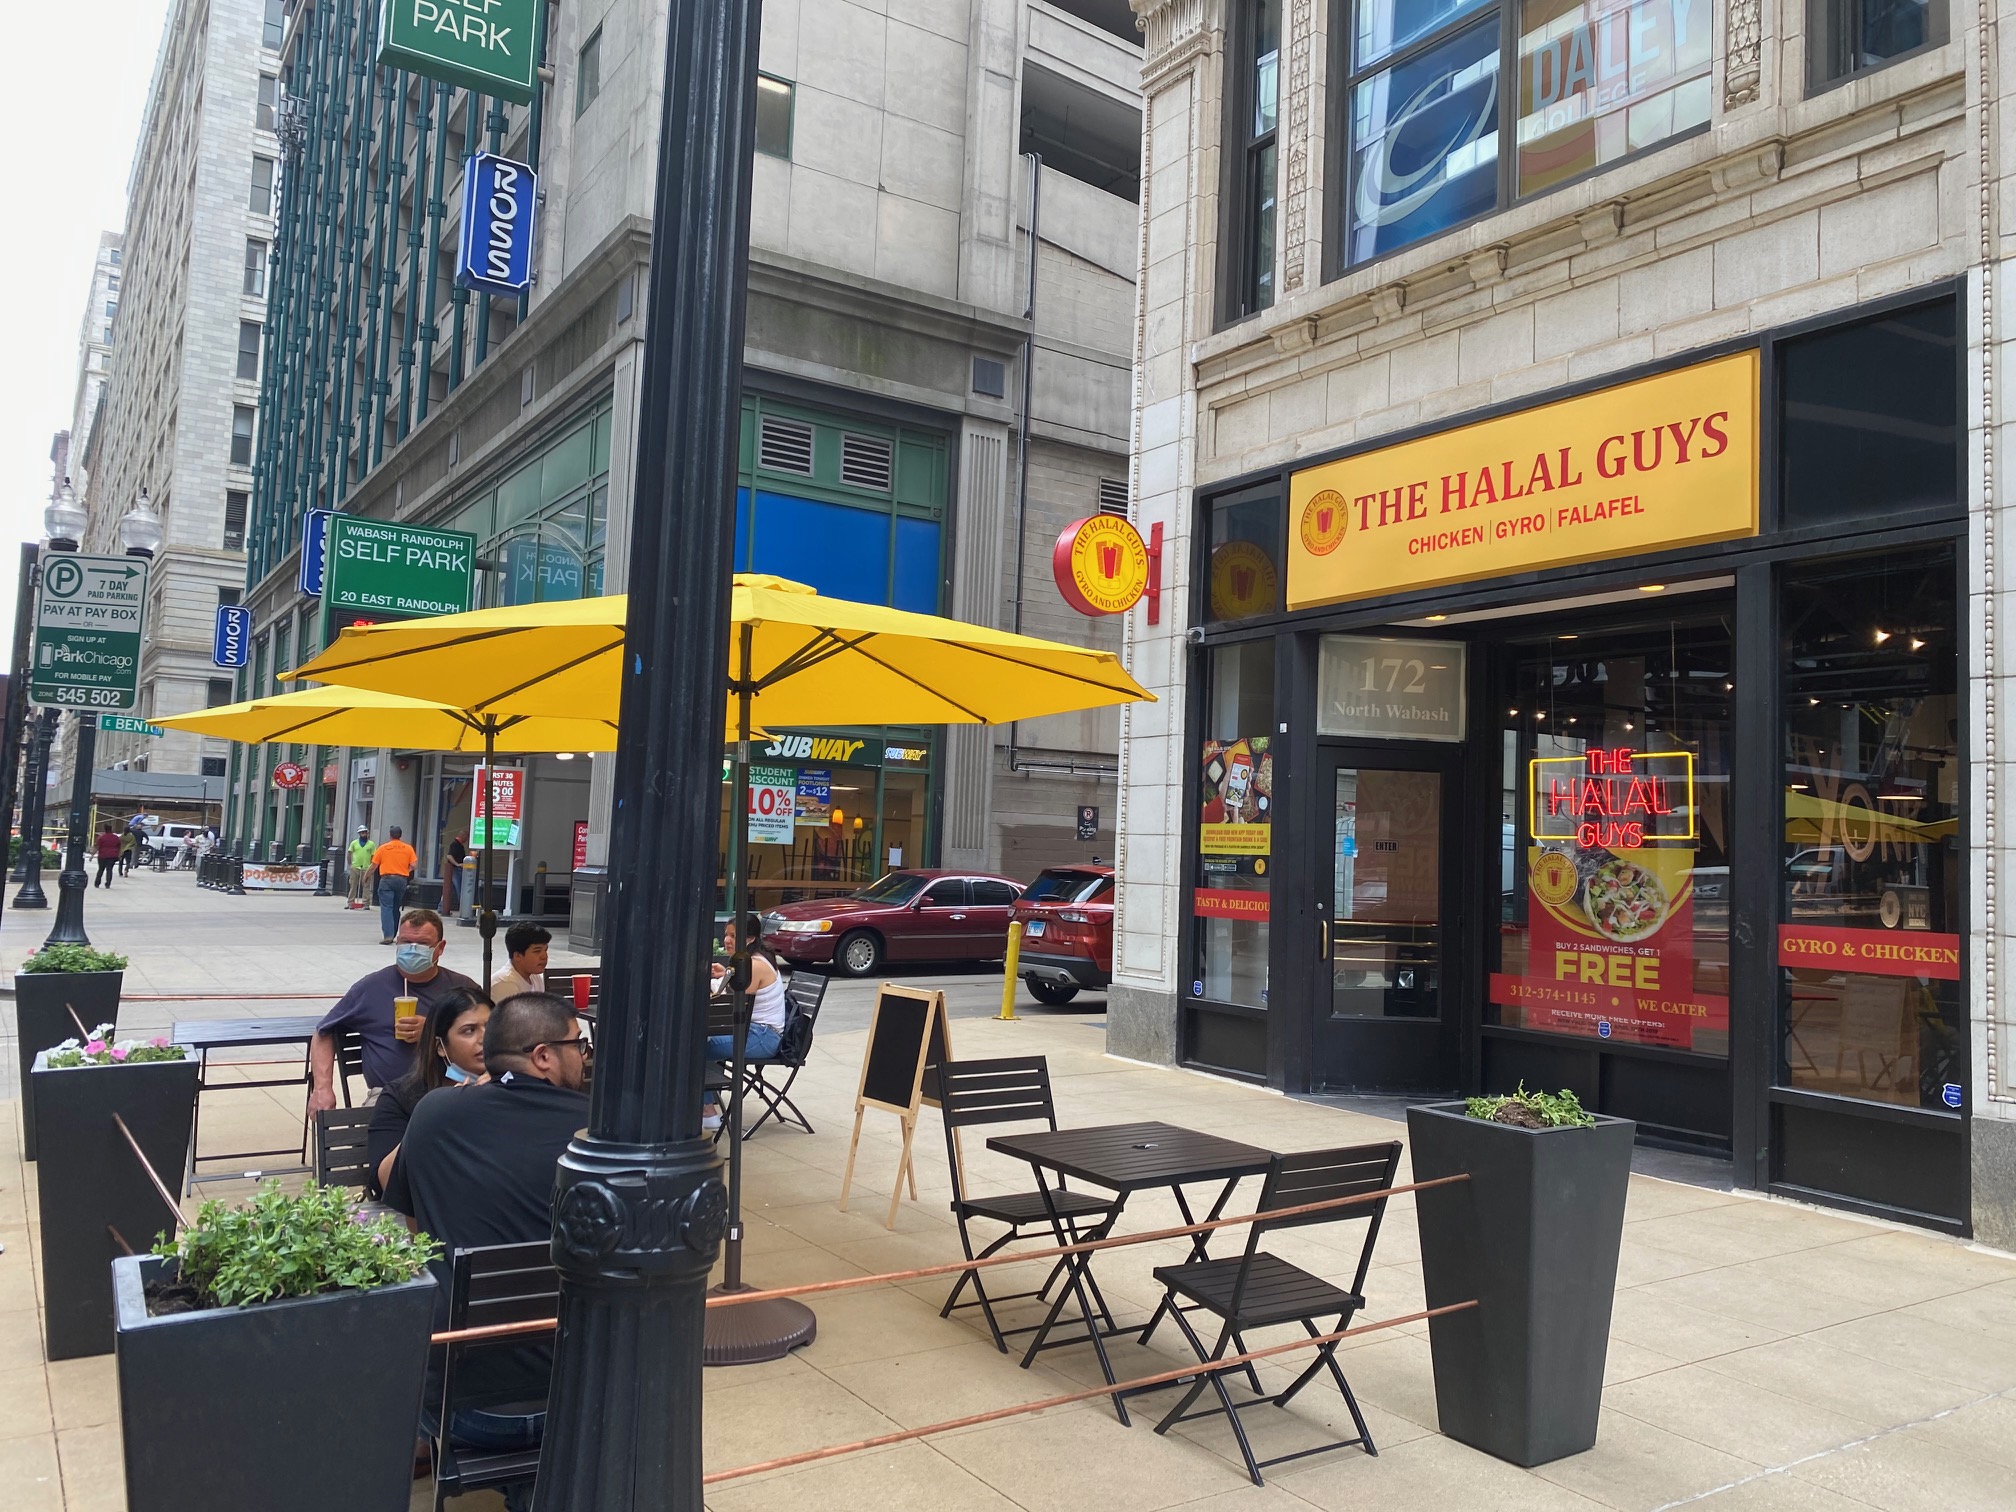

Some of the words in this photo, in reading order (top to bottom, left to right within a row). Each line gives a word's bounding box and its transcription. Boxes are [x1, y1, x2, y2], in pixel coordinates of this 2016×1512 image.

[413, 0, 512, 56] PARK
[1532, 0, 1691, 113] DALEY
[1532, 71, 1647, 139] COLLEGE
[487, 163, 518, 278] ROSS
[1354, 480, 1429, 531] THE
[1440, 447, 1583, 514] HALAL
[1595, 411, 1729, 479] GUYS
[1304, 506, 1314, 526] THE
[1312, 493, 1334, 507] HALAL
[1408, 525, 1484, 556] CHICKEN
[1495, 512, 1546, 540] GYRO
[1557, 495, 1645, 528] FALAFEL
[346, 526, 397, 542] WABASH
[401, 533, 464, 550] RANDOLPH
[1074, 530, 1091, 556] THE
[1090, 518, 1125, 534] HALAL
[1126, 532, 1144, 566] GUYS
[1304, 534, 1314, 550] GYRO
[1326, 526, 1345, 551] CHICKEN
[339, 539, 402, 563] SELF
[406, 547, 467, 573] PARK
[88, 591, 105, 600] PAID
[106, 592, 138, 602] PARKING
[100, 580, 106, 590] 7
[109, 581, 128, 592] DAY
[1076, 570, 1093, 598] GYRO
[1093, 596, 1112, 608] AND
[1112, 580, 1144, 608] CHICKEN
[44, 604, 66, 616] PAY
[67, 606, 82, 616] AT
[85, 608, 108, 618] PAY
[111, 610, 137, 620] BOX
[340, 590, 357, 602] 20
[361, 594, 393, 606] EAST
[397, 598, 460, 614] RANDOLPH
[67, 634, 86, 643] SIGN
[225, 610, 241, 663] ROSS
[54, 648, 132, 668] ParkChicago
[70, 673, 97, 682] MOBILE
[1360, 657, 1426, 694] 172
[38, 690, 54, 698] ZONE
[56, 687, 86, 703] 545
[90, 690, 120, 706] 502
[1334, 701, 1381, 718] North
[1386, 703, 1449, 722] Wabash
[765, 735, 865, 762] SUBWAY
[885, 747, 926, 761] SUBWAY
[750, 766, 792, 777] STUDENT
[1586, 748, 1632, 774] THE
[800, 786, 806, 796] 2
[812, 787, 828, 796] $12
[1552, 776, 1672, 816] HALAL
[776, 808, 792, 816] OFF
[1376, 842, 1397, 851] ENTER
[1578, 822, 1643, 848] GUYS
[1535, 862, 1544, 876] THE
[1542, 855, 1563, 863] HALAL
[1196, 897, 1220, 908] TASTY
[1222, 900, 1228, 908] &
[1908, 904, 1926, 918] NYC
[1556, 942, 1572, 950] BUY
[1580, 944, 1636, 956] SANDWICHES,
[1638, 948, 1655, 956] GET
[1783, 938, 1837, 955] GYRO
[1842, 942, 1856, 956] &
[1860, 943, 1958, 964] CHICKEN
[1555, 952, 1660, 990] FREE
[1510, 984, 1596, 1004] 312-374-1145
[1638, 998, 1658, 1012] WE
[1661, 1001, 1708, 1017] CATER
[1552, 1009, 1582, 1019] RECEIVE
[1584, 1012, 1606, 1022] MORE
[1608, 1016, 1630, 1024] FREE
